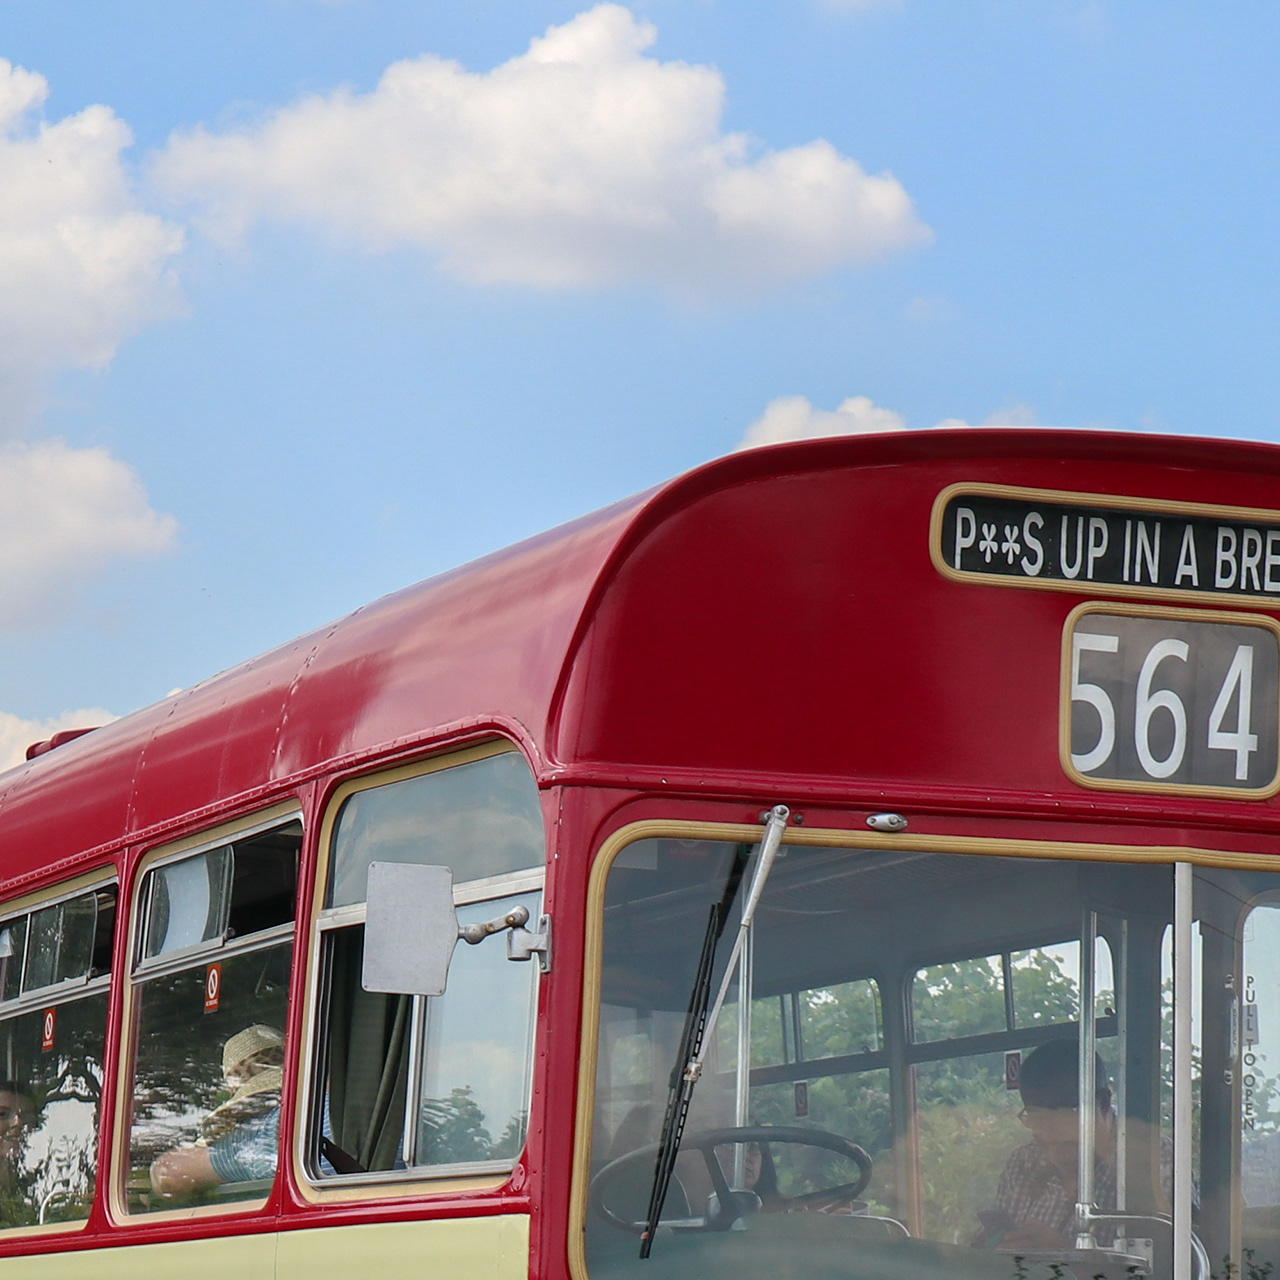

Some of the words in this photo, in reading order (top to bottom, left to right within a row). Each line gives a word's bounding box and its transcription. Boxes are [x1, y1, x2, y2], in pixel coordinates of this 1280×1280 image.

[1060, 514, 1109, 580] UP
[1123, 520, 1161, 584] IN
[1174, 524, 1200, 587] A
[1070, 632, 1258, 781] 564
[1245, 975, 1256, 1031] PULL
[1244, 1039, 1256, 1066] TO
[1244, 1074, 1256, 1130] OPEN
